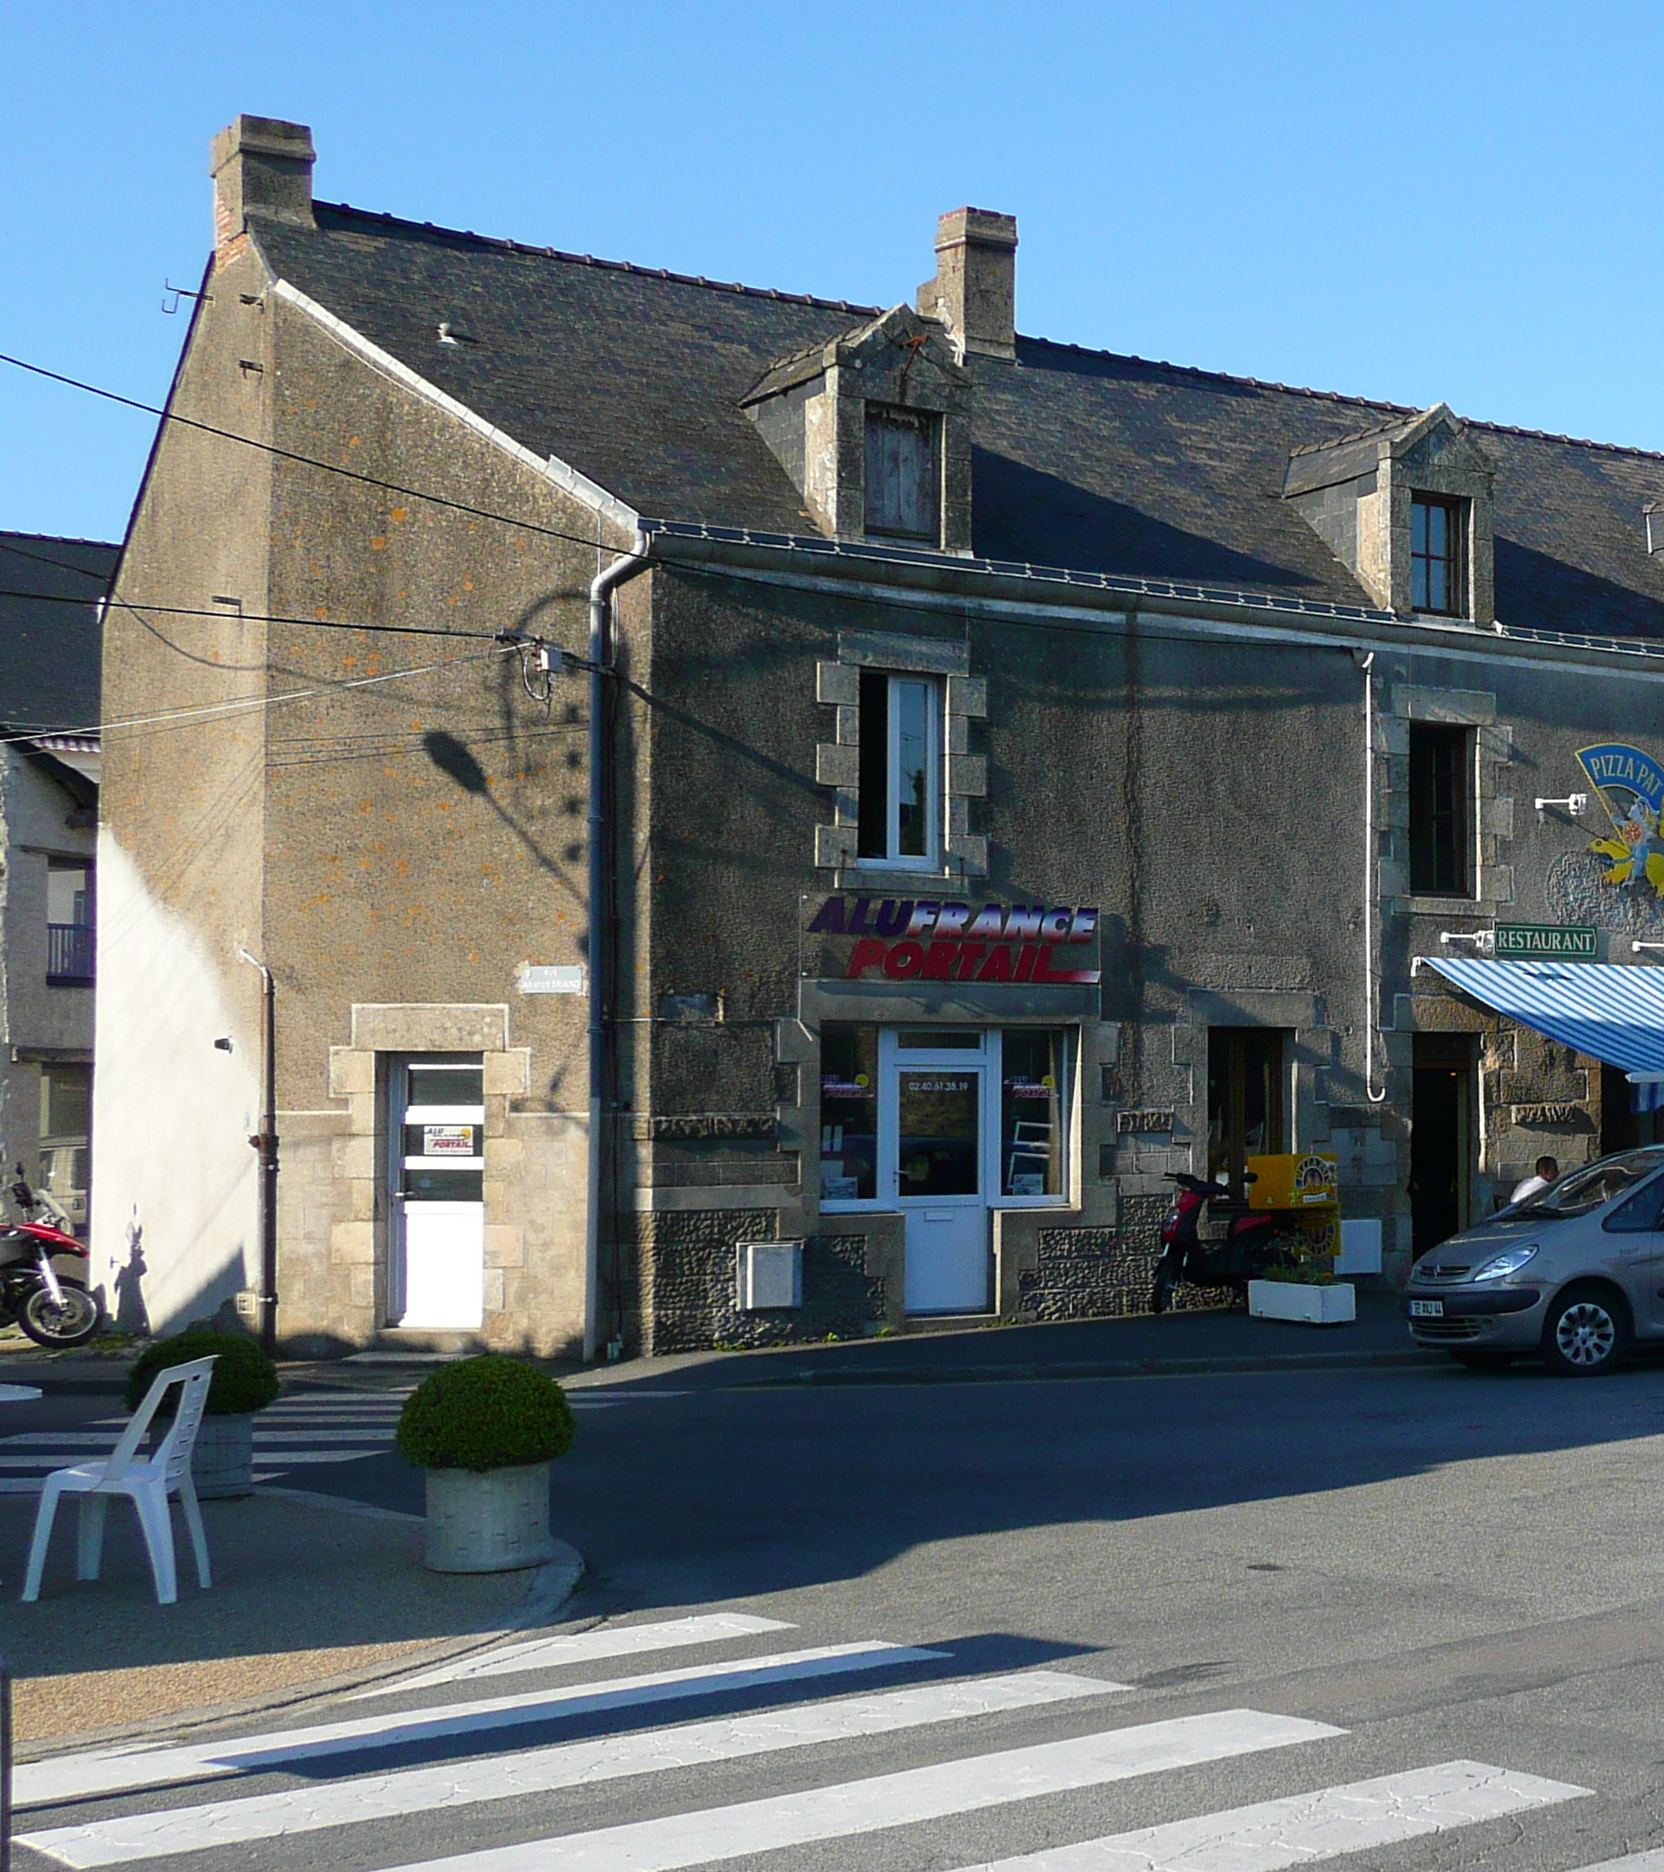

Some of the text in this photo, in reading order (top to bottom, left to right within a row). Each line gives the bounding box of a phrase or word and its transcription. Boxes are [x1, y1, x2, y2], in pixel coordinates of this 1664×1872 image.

[1590, 755, 1634, 780] PIZZA
[1498, 931, 1593, 951] RESTAURANT
[847, 938, 1101, 983] PORTAIL
[432, 1141, 475, 1149] PORTAIL
